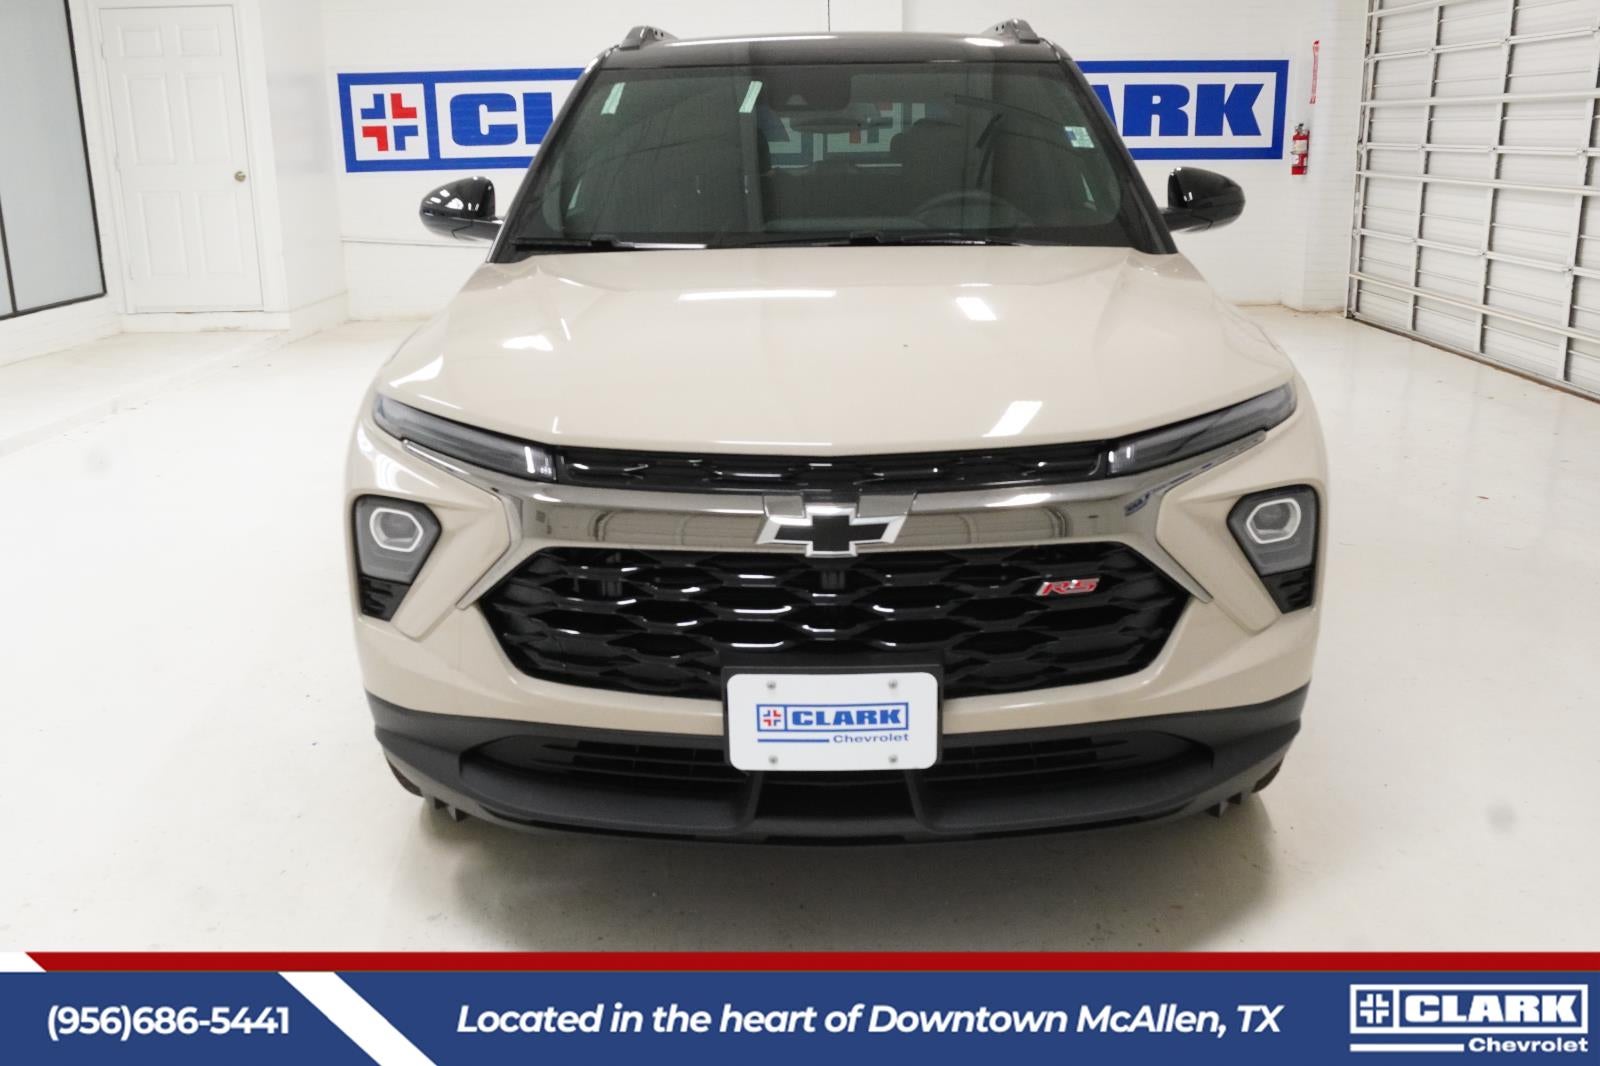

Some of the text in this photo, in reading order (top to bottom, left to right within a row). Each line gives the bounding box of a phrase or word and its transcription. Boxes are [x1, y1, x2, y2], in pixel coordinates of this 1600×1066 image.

[1035, 578, 1100, 597] RS
[792, 709, 901, 726] CLARK
[833, 733, 909, 744] Chevrolet
